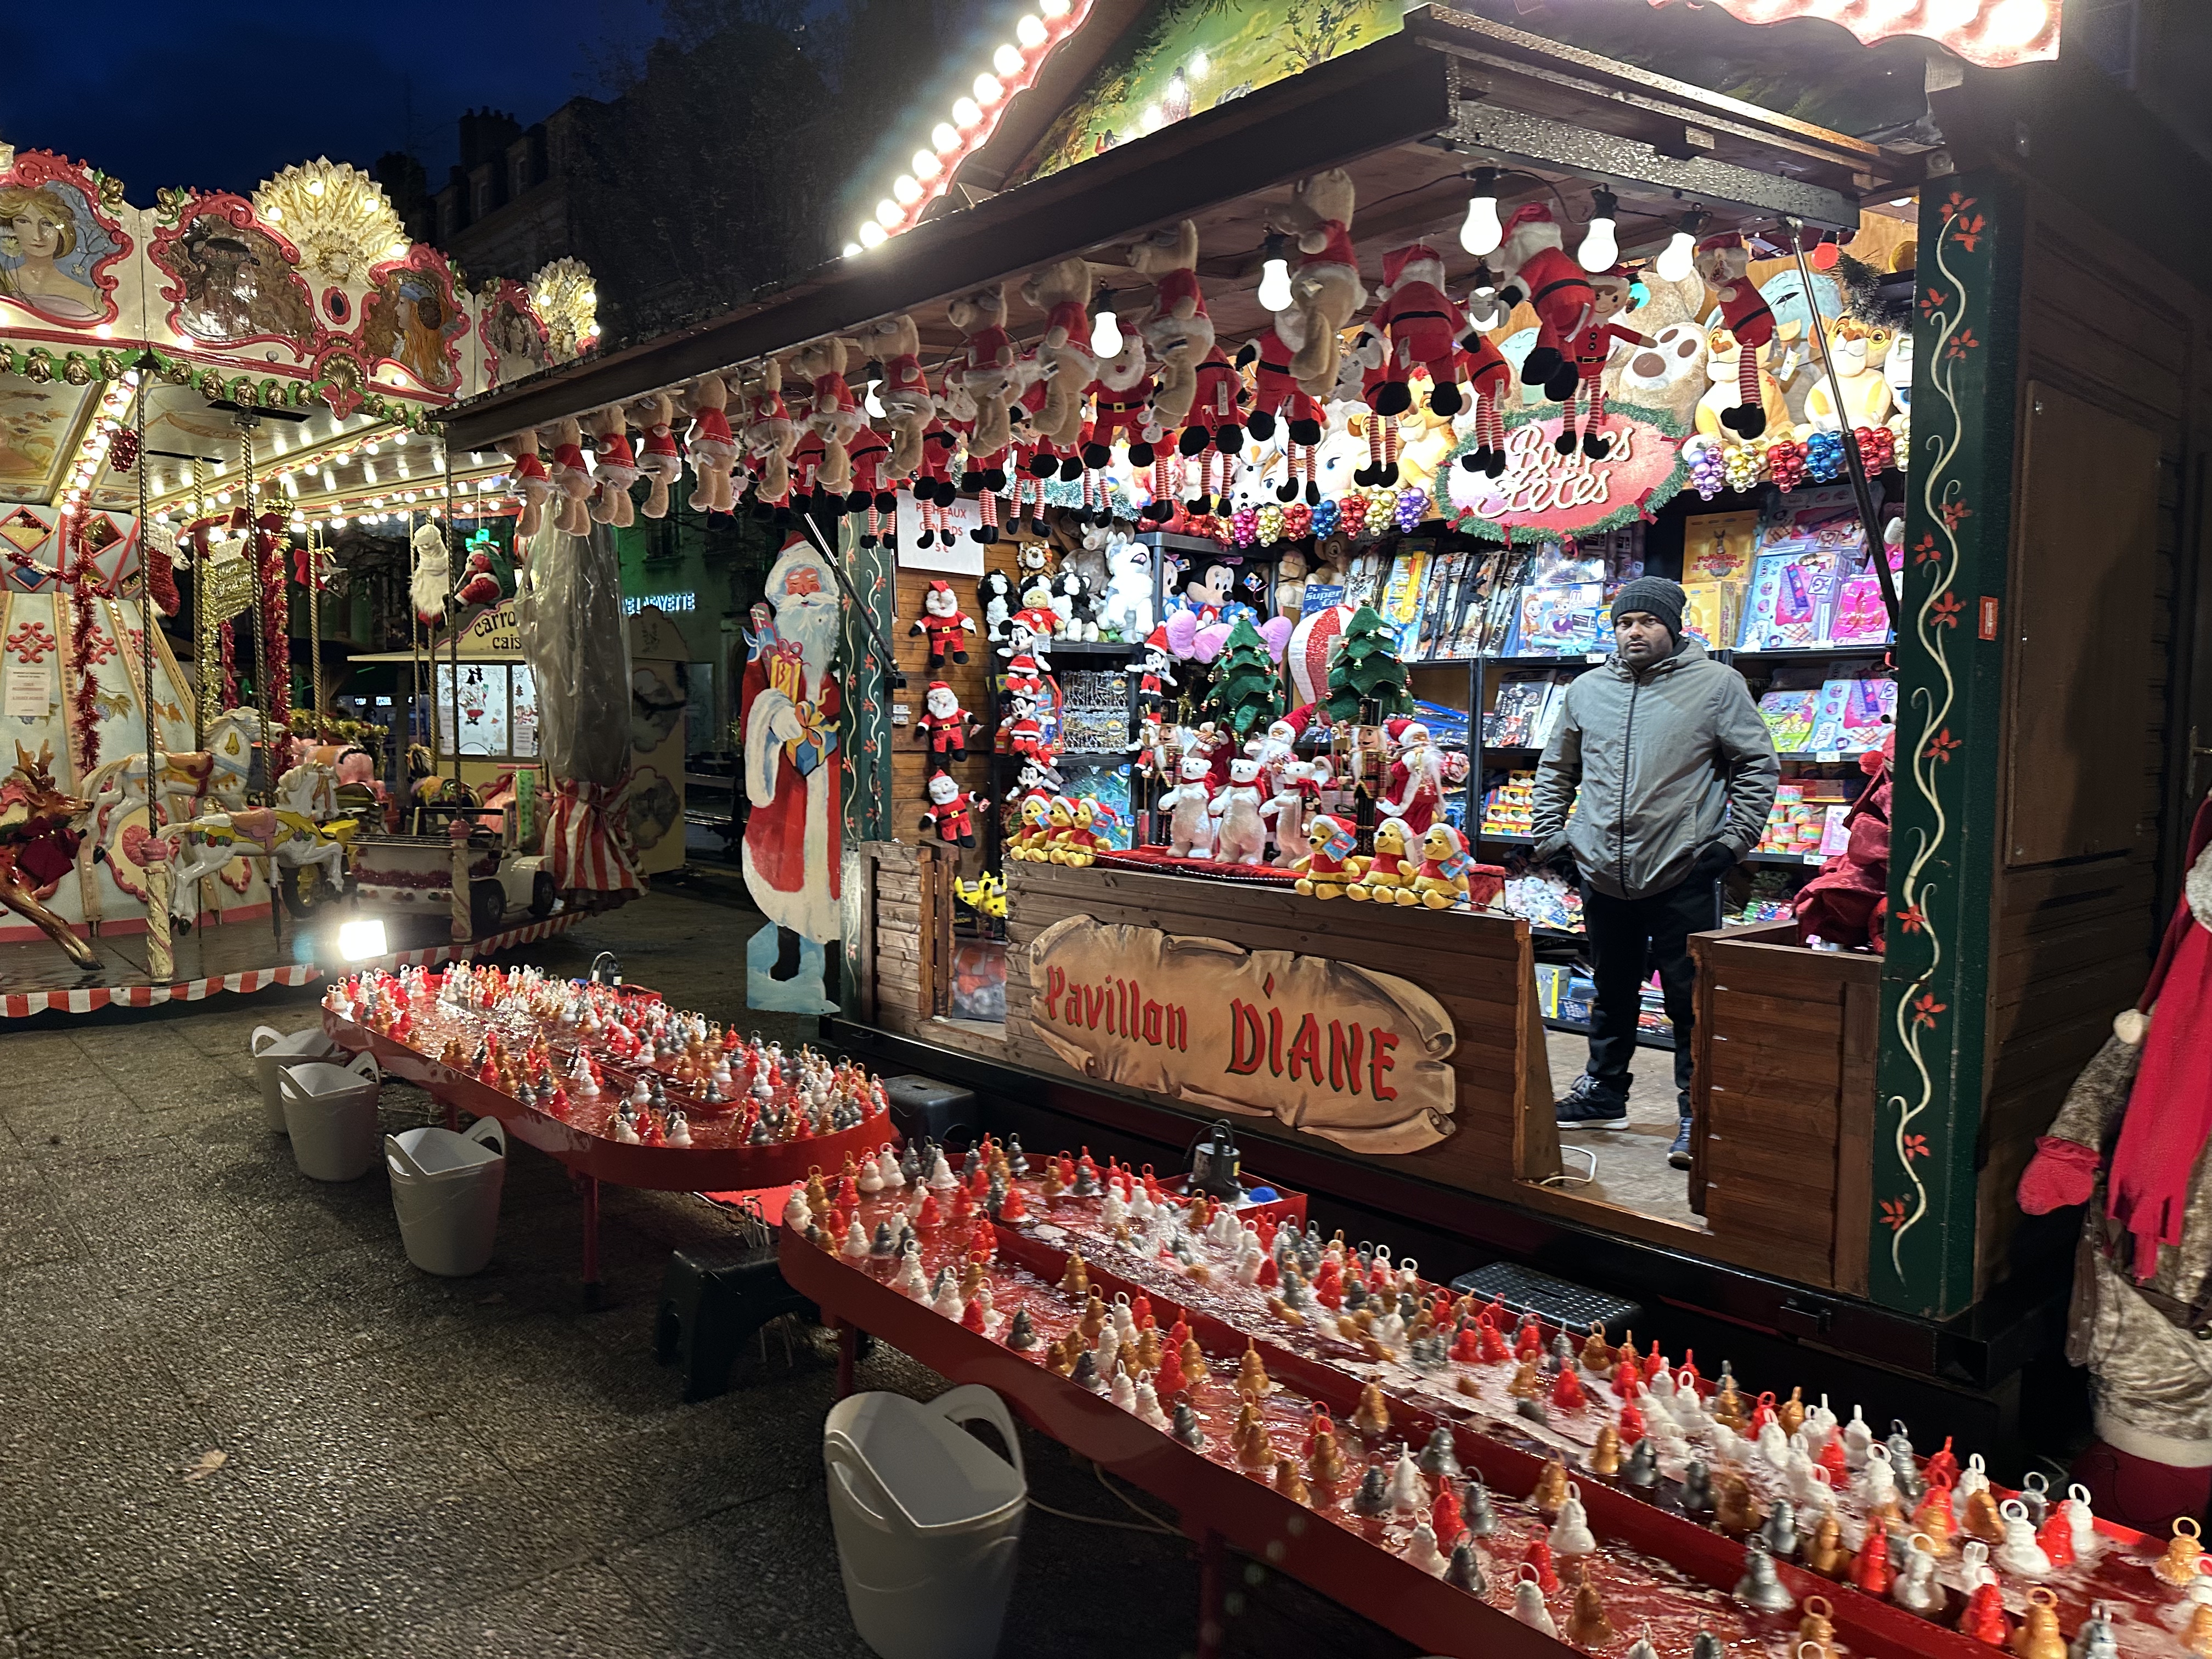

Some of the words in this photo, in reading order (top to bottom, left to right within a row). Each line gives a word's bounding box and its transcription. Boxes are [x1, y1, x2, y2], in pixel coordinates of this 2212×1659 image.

[935, 542, 941, 552] 5
[1305, 590, 1342, 601] Super
[1045, 965, 1188, 1053] Pavillon
